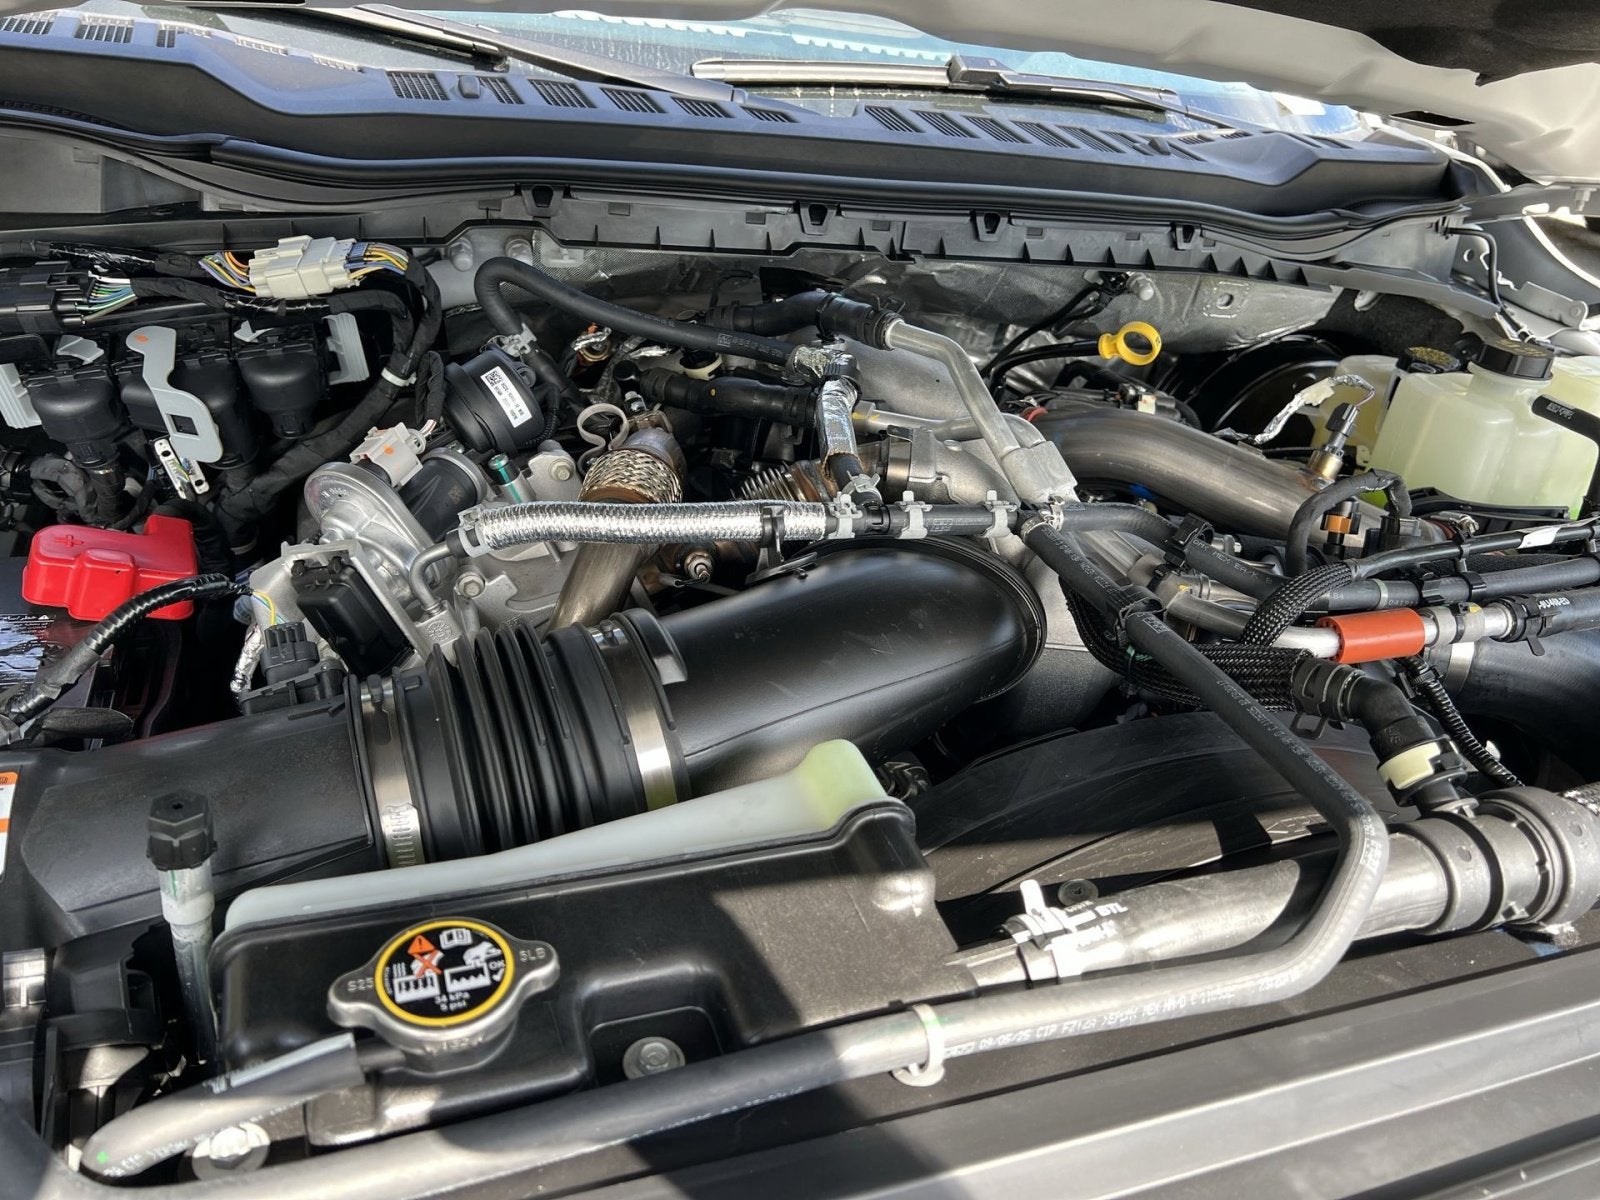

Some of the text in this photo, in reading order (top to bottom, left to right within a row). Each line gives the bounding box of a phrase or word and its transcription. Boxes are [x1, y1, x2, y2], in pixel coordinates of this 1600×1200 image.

[488, 960, 506, 971] OK
[449, 991, 470, 1002] kPa
[440, 1001, 468, 1012] 5 psi
